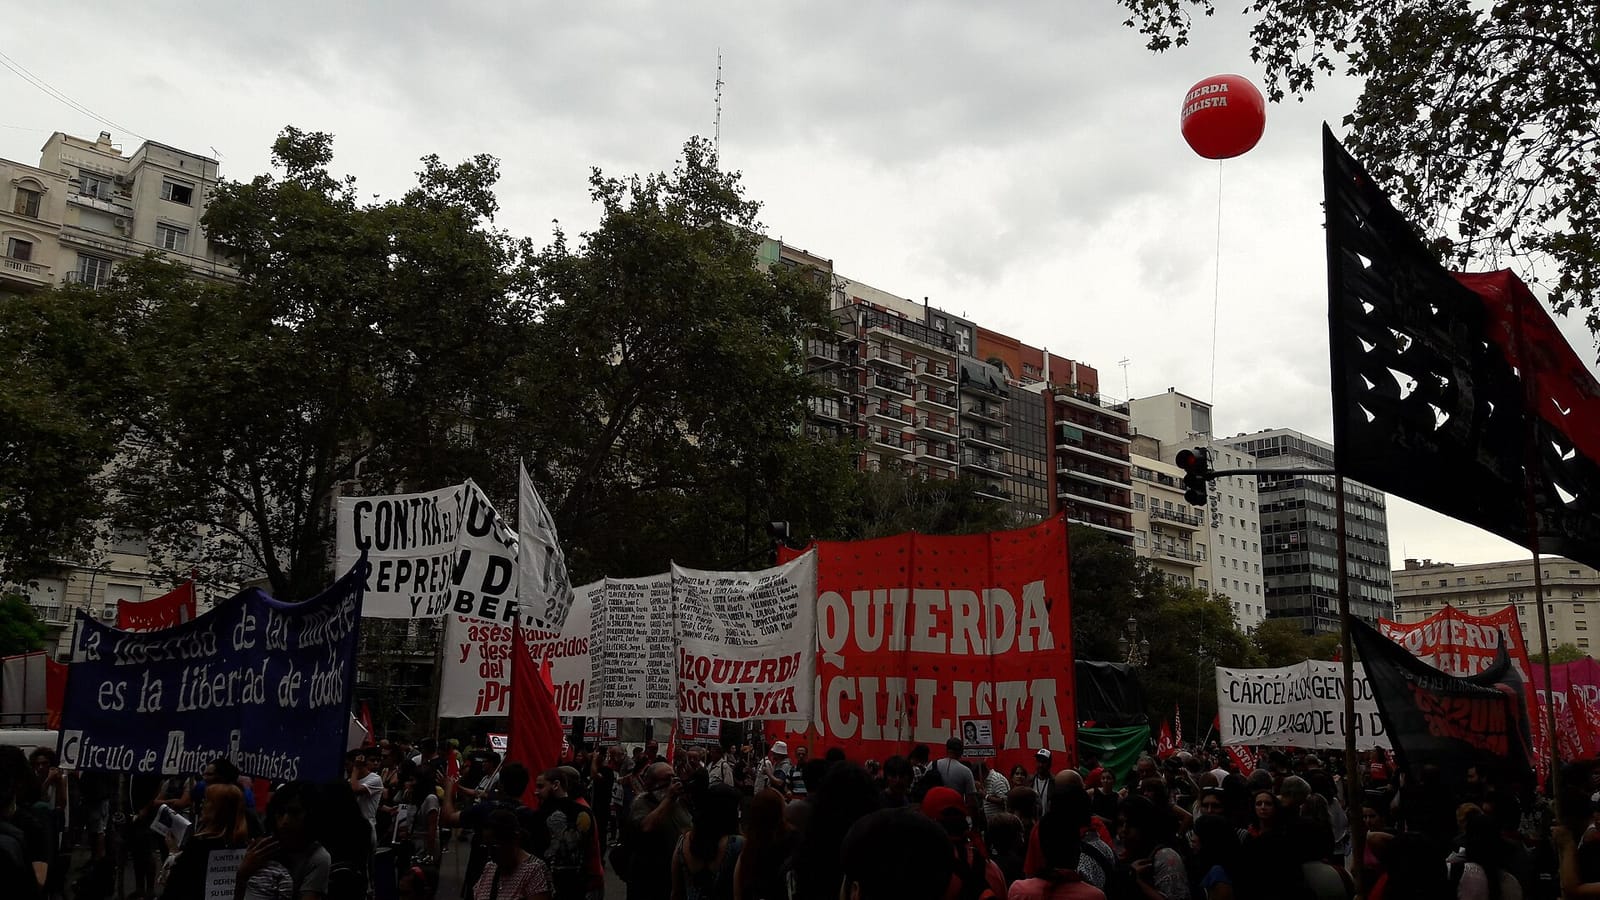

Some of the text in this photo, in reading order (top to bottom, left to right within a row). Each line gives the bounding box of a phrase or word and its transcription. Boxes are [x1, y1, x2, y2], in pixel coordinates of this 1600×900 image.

[1185, 83, 1229, 104] UIERDA
[354, 496, 441, 551] CONTRA
[410, 595, 423, 617] Y
[72, 619, 101, 663] La
[233, 603, 256, 651] de
[266, 608, 292, 651] las
[816, 579, 1055, 669] QUIERDA
[460, 643, 471, 663] y
[480, 660, 504, 678] del
[680, 647, 801, 688] IZQUIERDA
[98, 680, 127, 711] es
[137, 669, 163, 712] la
[177, 656, 271, 712] libertad
[278, 658, 302, 708] de
[679, 680, 798, 719] SOCIALISTA
[1230, 677, 1286, 705] CÁRCEL
[1312, 675, 1375, 702] GENOC
[785, 676, 1067, 753] CIALISTA
[1232, 713, 1257, 736] NO
[1277, 711, 1314, 734] PAGO
[1313, 710, 1335, 735] DE
[138, 749, 157, 772] de
